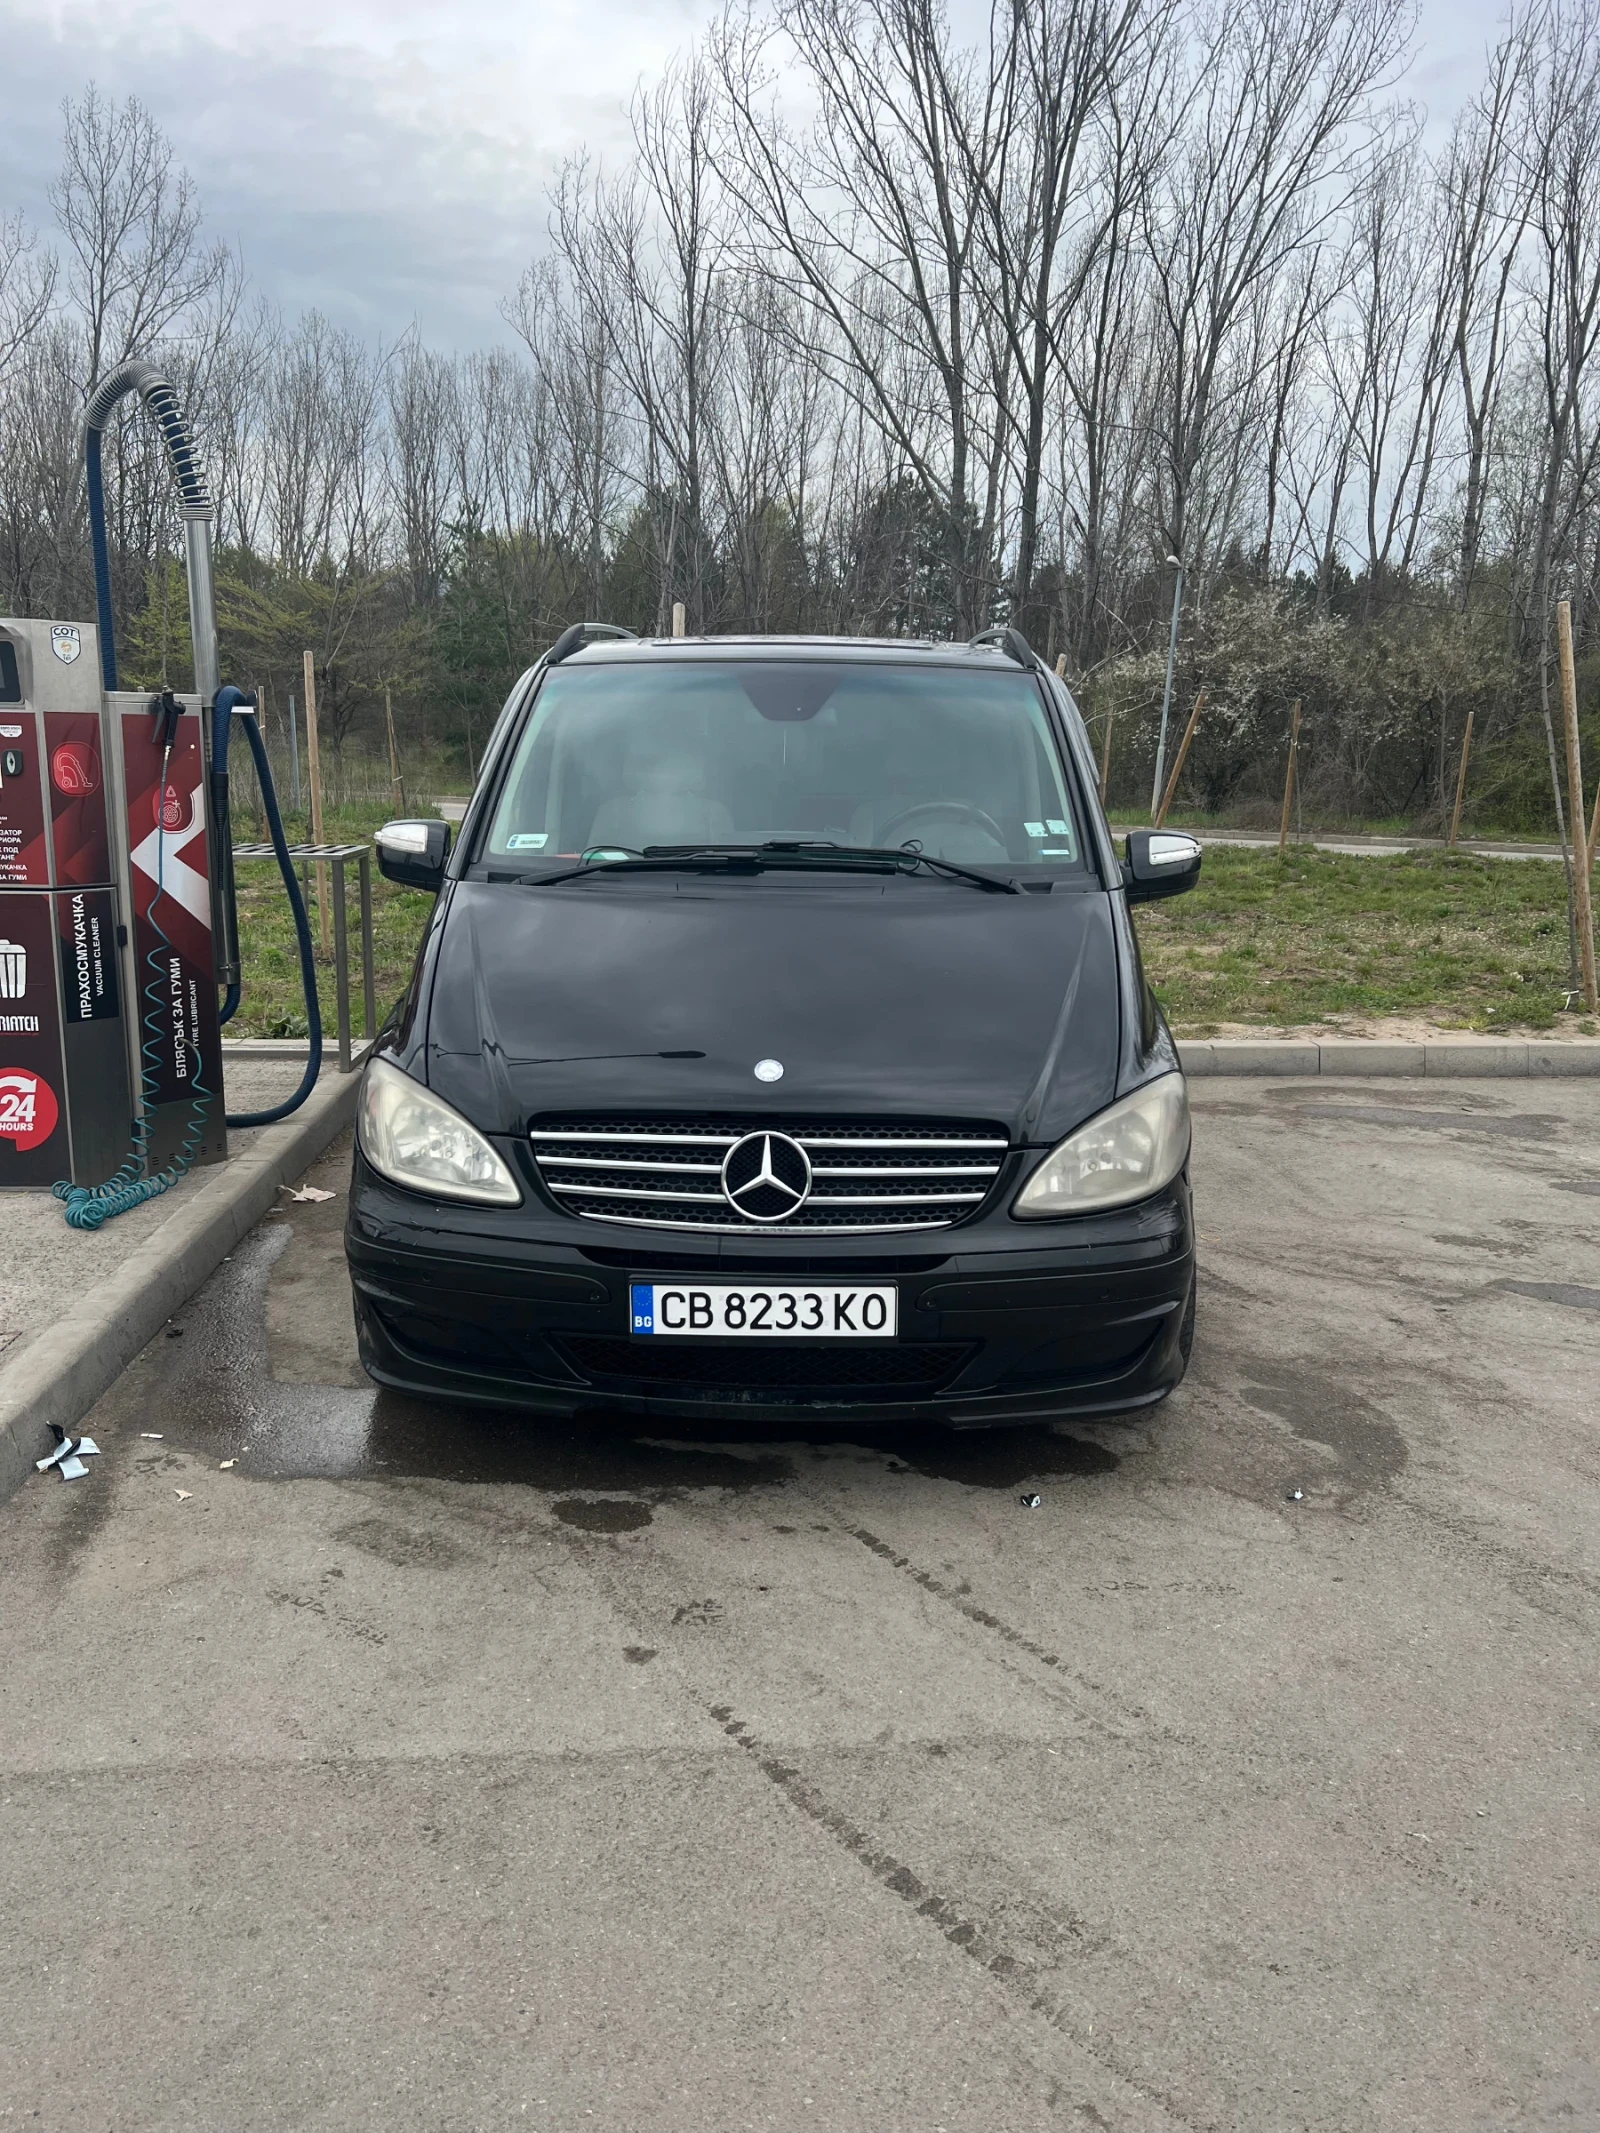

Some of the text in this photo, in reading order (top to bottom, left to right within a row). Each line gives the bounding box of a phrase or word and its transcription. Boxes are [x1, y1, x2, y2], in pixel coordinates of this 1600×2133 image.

[72, 893, 92, 1018] ПРАХОСМУКАЧКА
[91, 917, 104, 996] VACUUM CLEANER
[169, 957, 187, 1078] БЛЯСЪК ЗА ГУМИ
[189, 979, 199, 1025] LUBRICANT
[0, 1093, 36, 1122] 24
[0, 1122, 34, 1131] HOURS
[634, 1316, 652, 1328] BG
[724, 1292, 824, 1330] 8233
